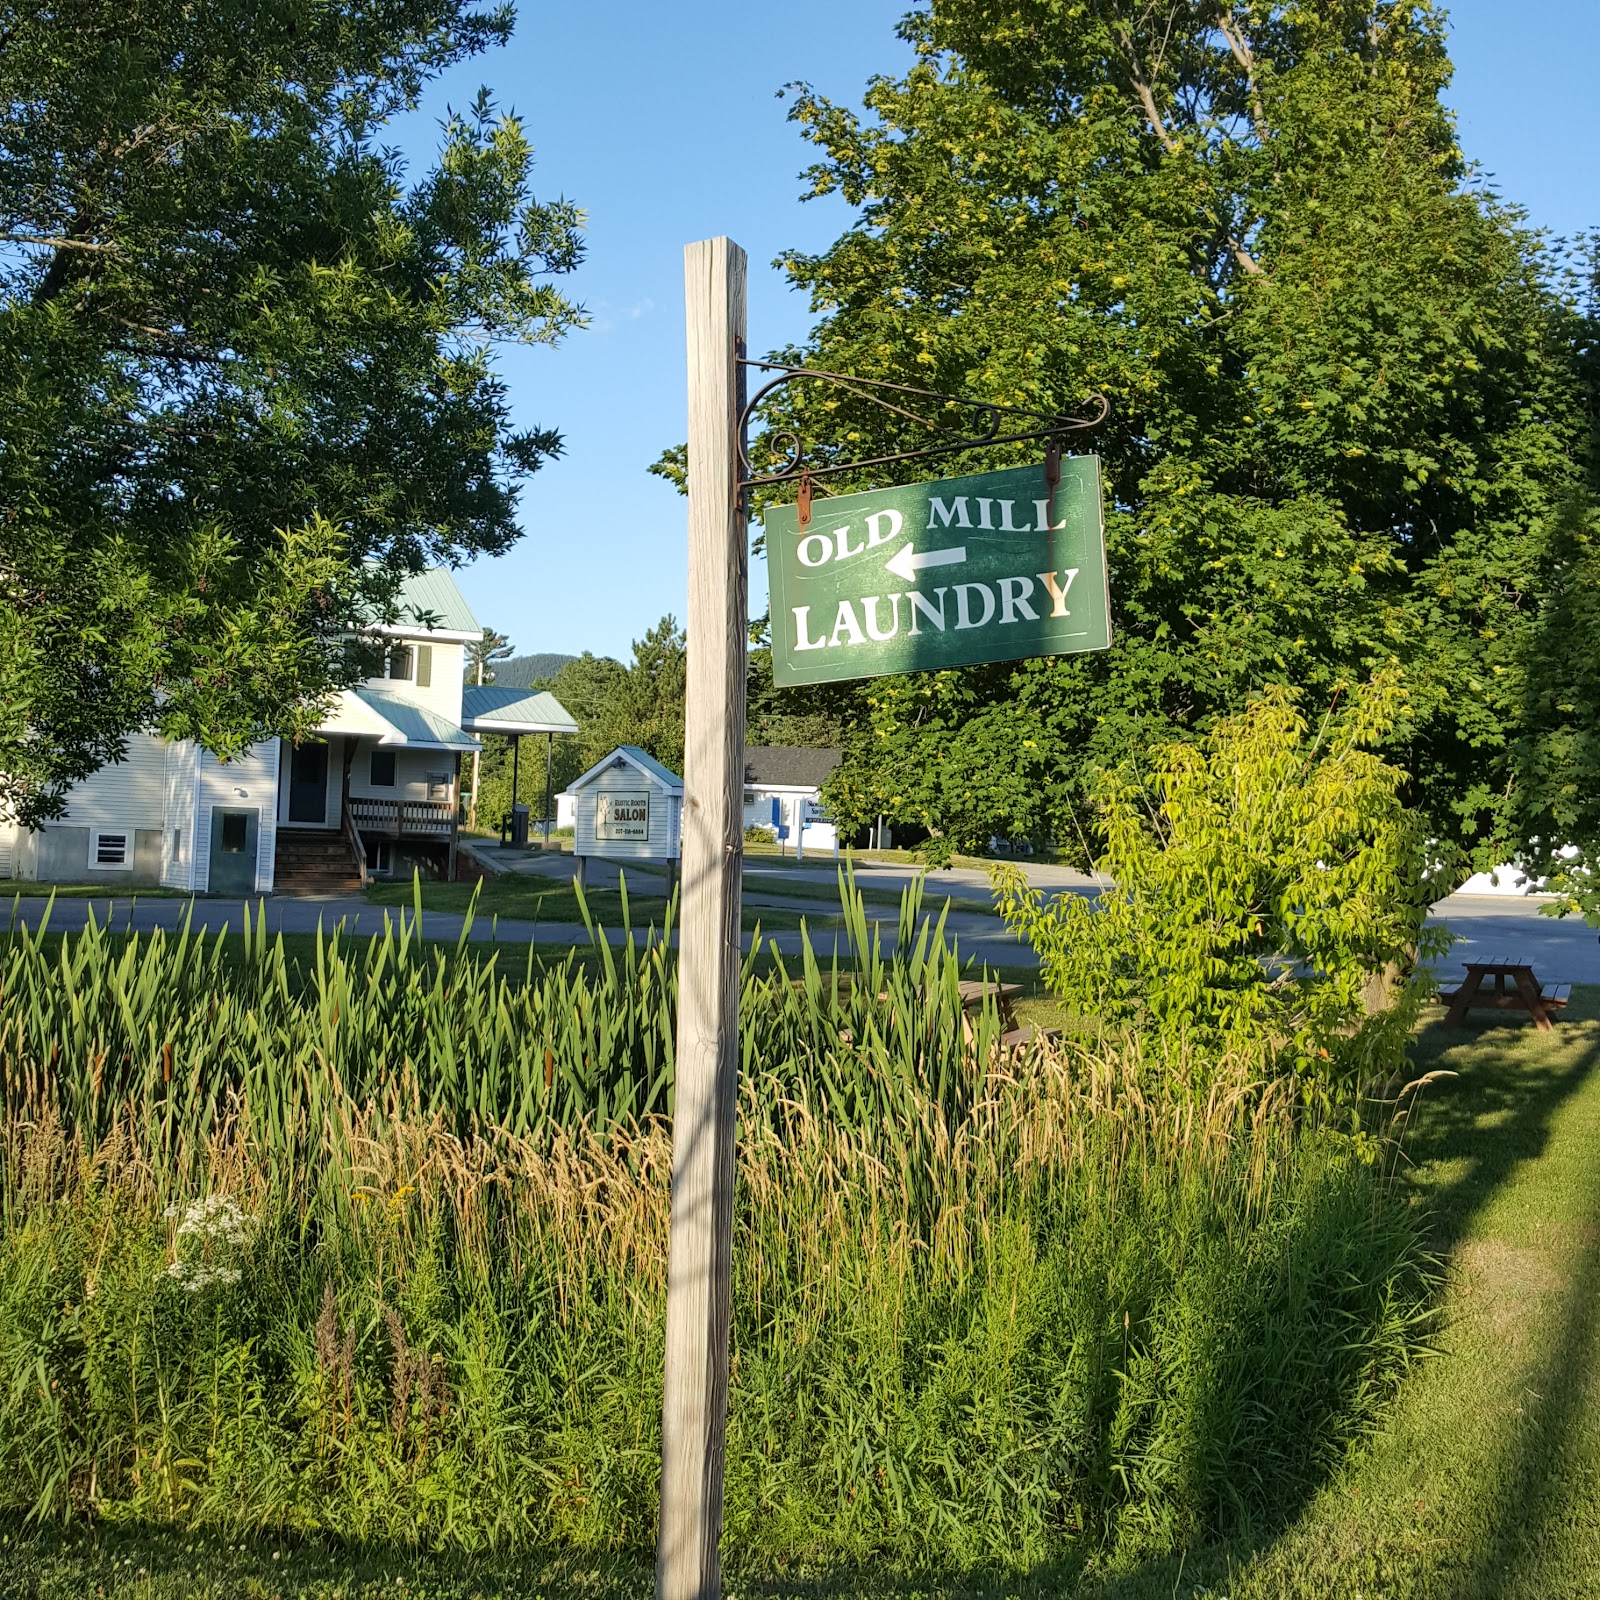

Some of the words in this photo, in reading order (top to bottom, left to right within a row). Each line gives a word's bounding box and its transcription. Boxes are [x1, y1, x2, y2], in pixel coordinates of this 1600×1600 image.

[796, 508, 903, 567] OLD
[926, 496, 1067, 532] MILL
[791, 568, 1080, 652] LAUNDRY
[614, 808, 646, 821] SALON
